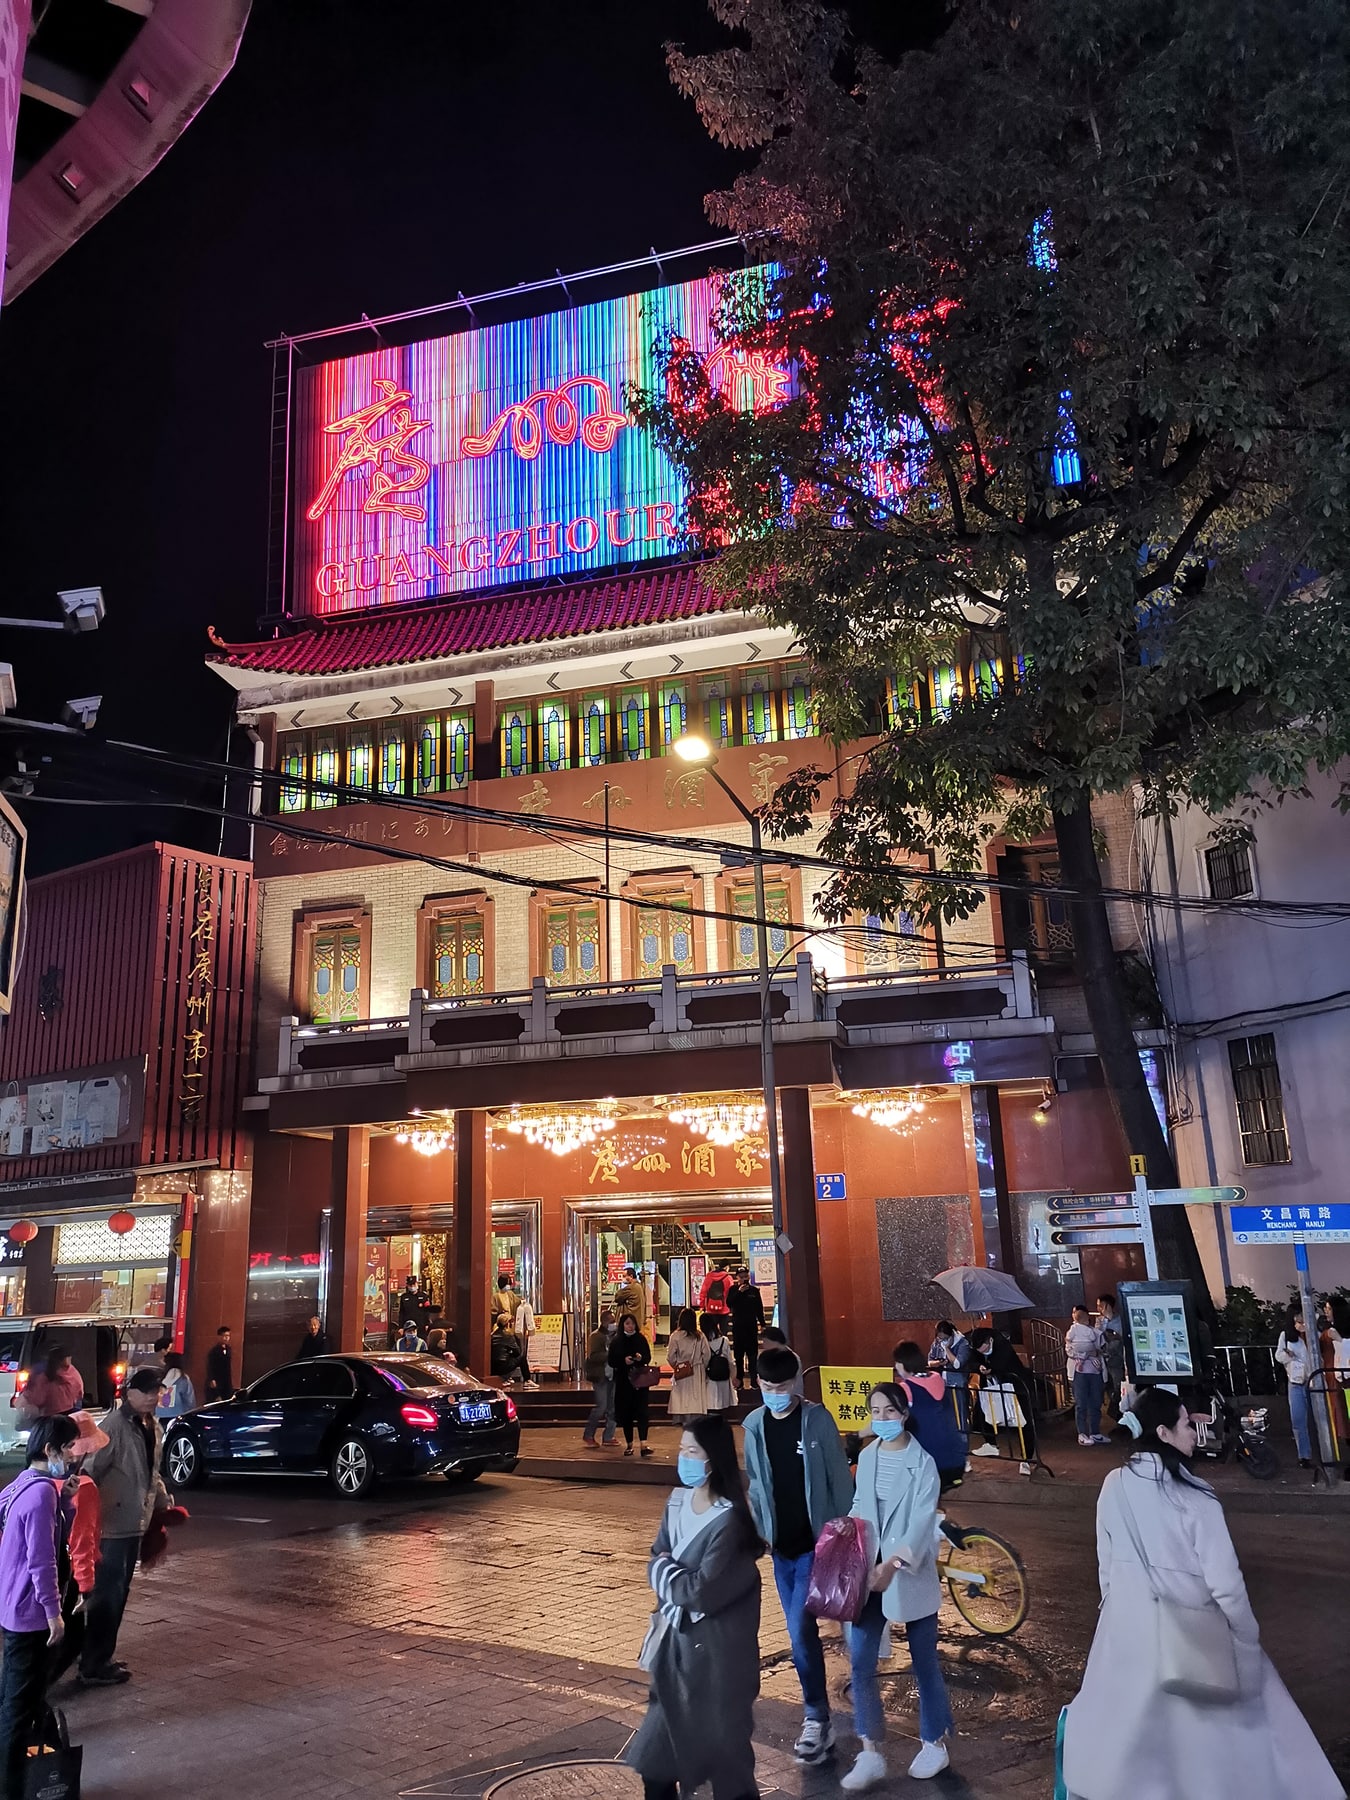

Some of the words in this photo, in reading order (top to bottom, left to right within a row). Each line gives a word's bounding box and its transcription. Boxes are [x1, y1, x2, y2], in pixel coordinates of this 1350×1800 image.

[822, 1183, 832, 1198] 2
[1260, 1206, 1331, 1220] 文昌南路
[1266, 1221, 1297, 1229] WENCHANG
[1305, 1220, 1325, 1228] NANLU
[829, 1379, 881, 1396] 共享单
[838, 1404, 868, 1421] 禁停
